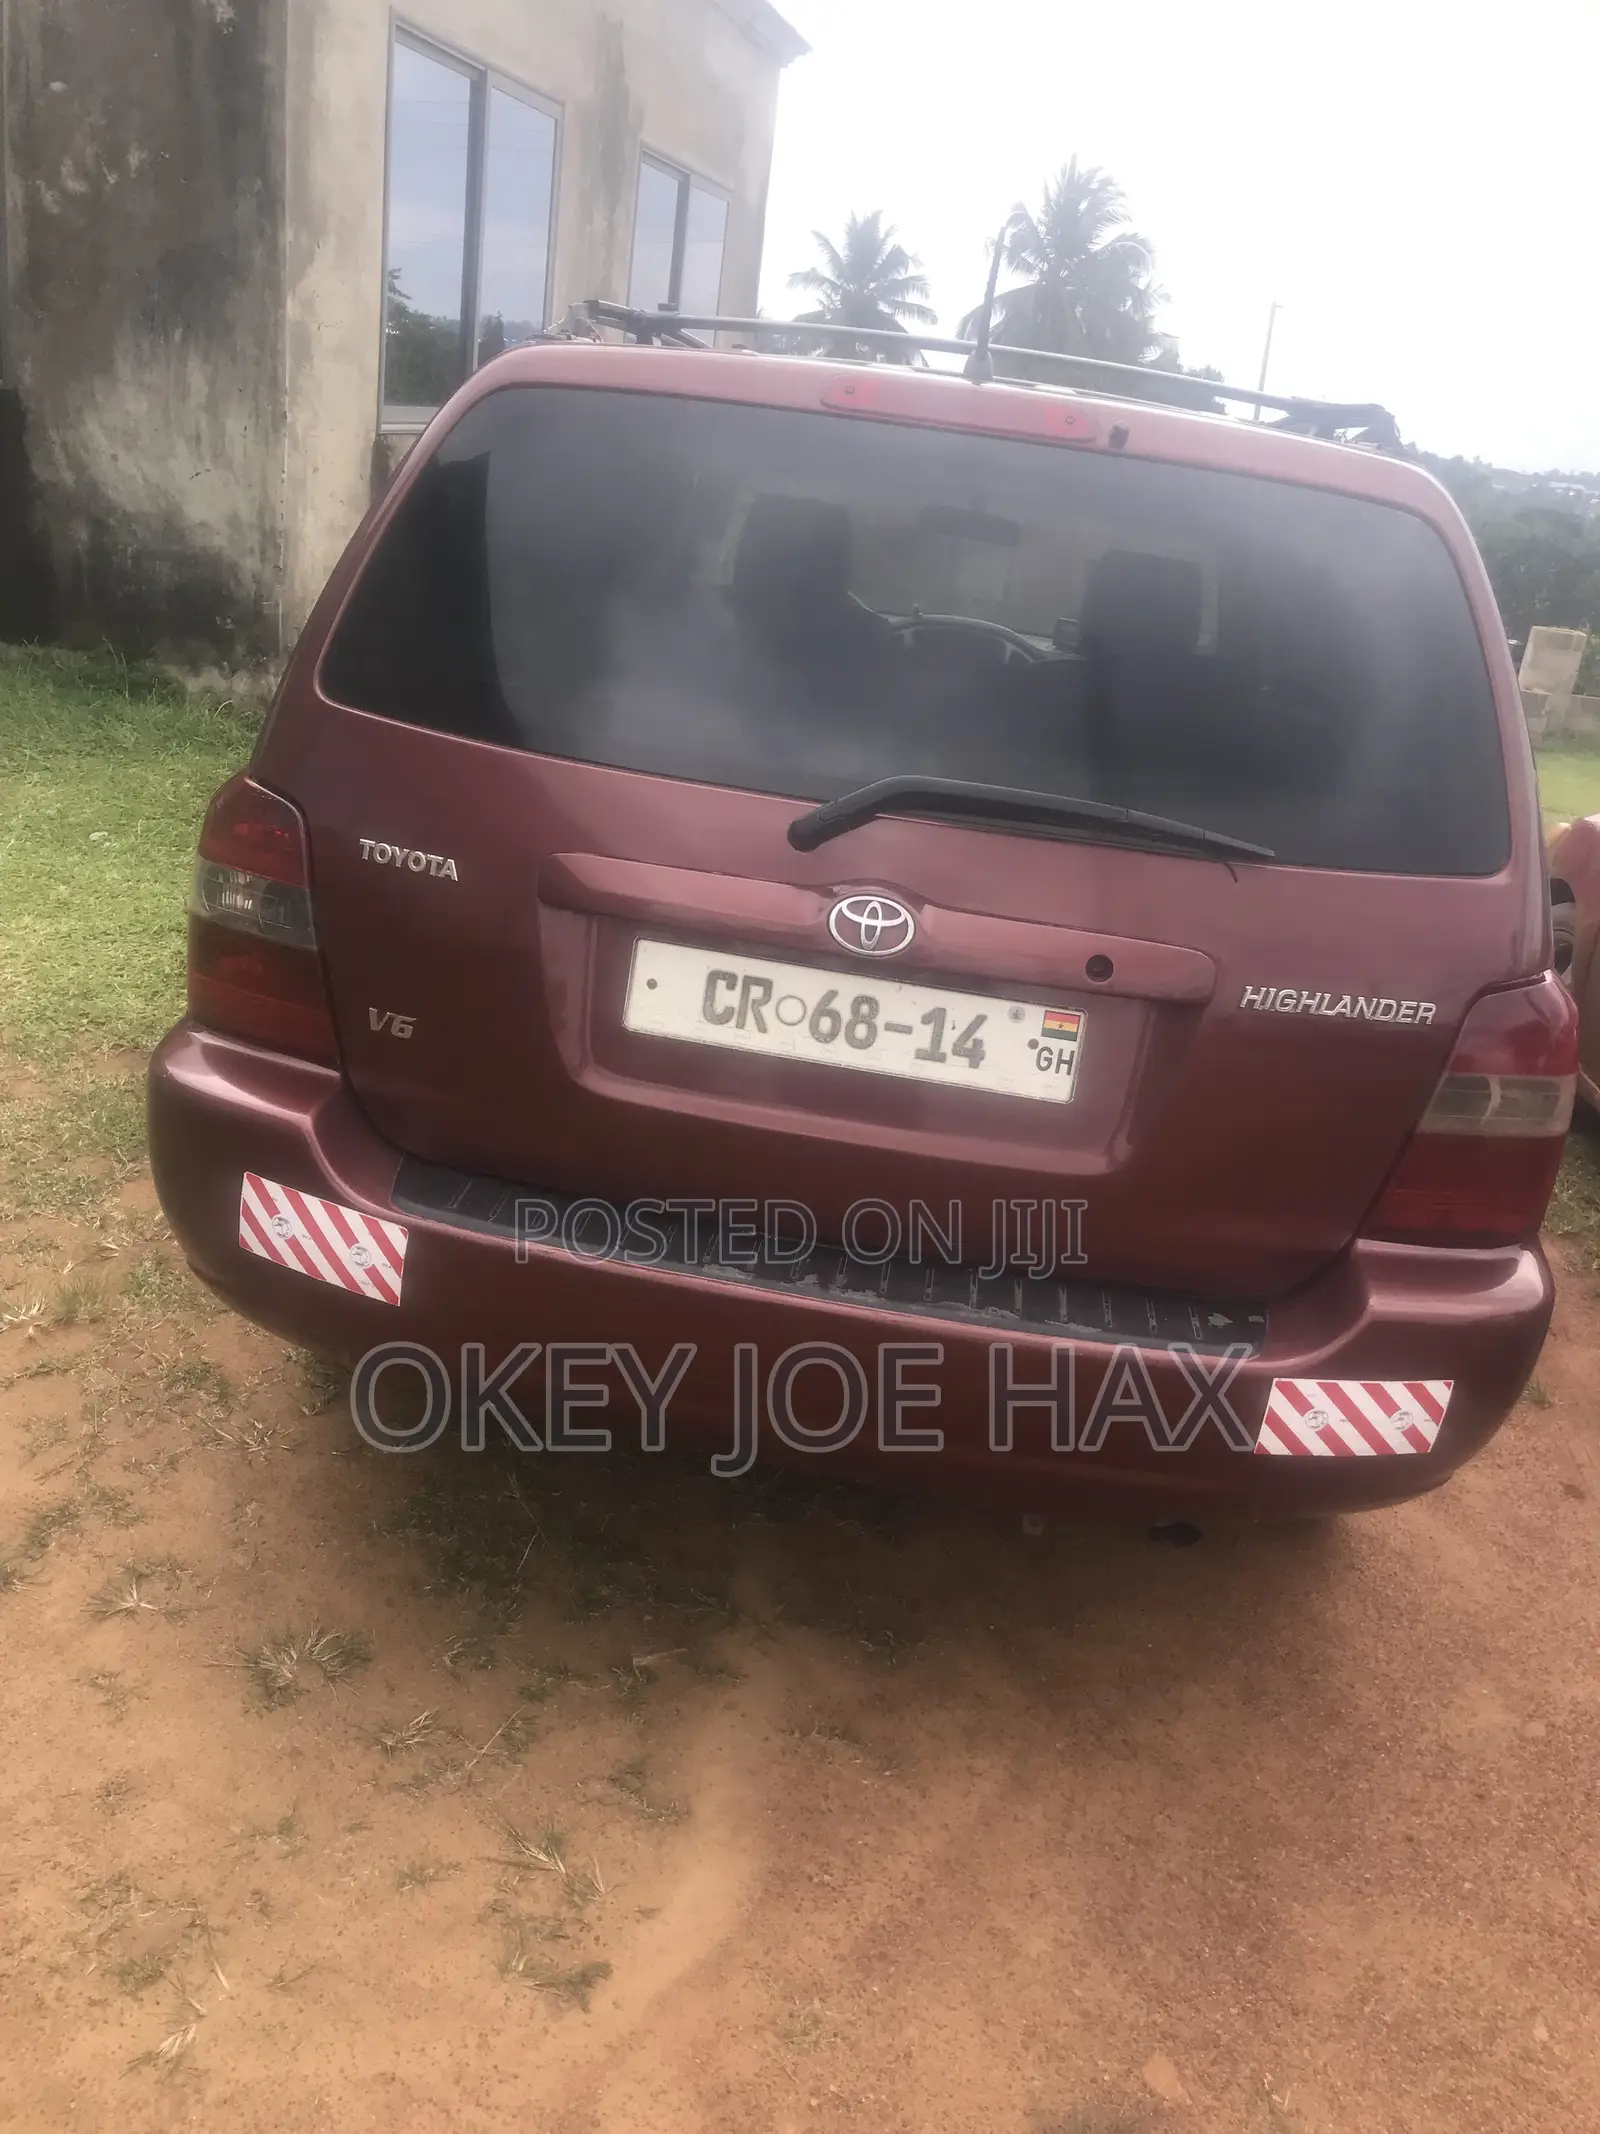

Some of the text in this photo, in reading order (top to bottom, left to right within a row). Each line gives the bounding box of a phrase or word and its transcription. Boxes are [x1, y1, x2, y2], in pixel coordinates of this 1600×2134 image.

[359, 838, 459, 882] TOYOTA
[368, 1006, 418, 1040] V6
[702, 968, 988, 1069] CR 68-14
[1238, 985, 1437, 1025] HIGHLANDER
[1035, 1045, 1076, 1077] GH
